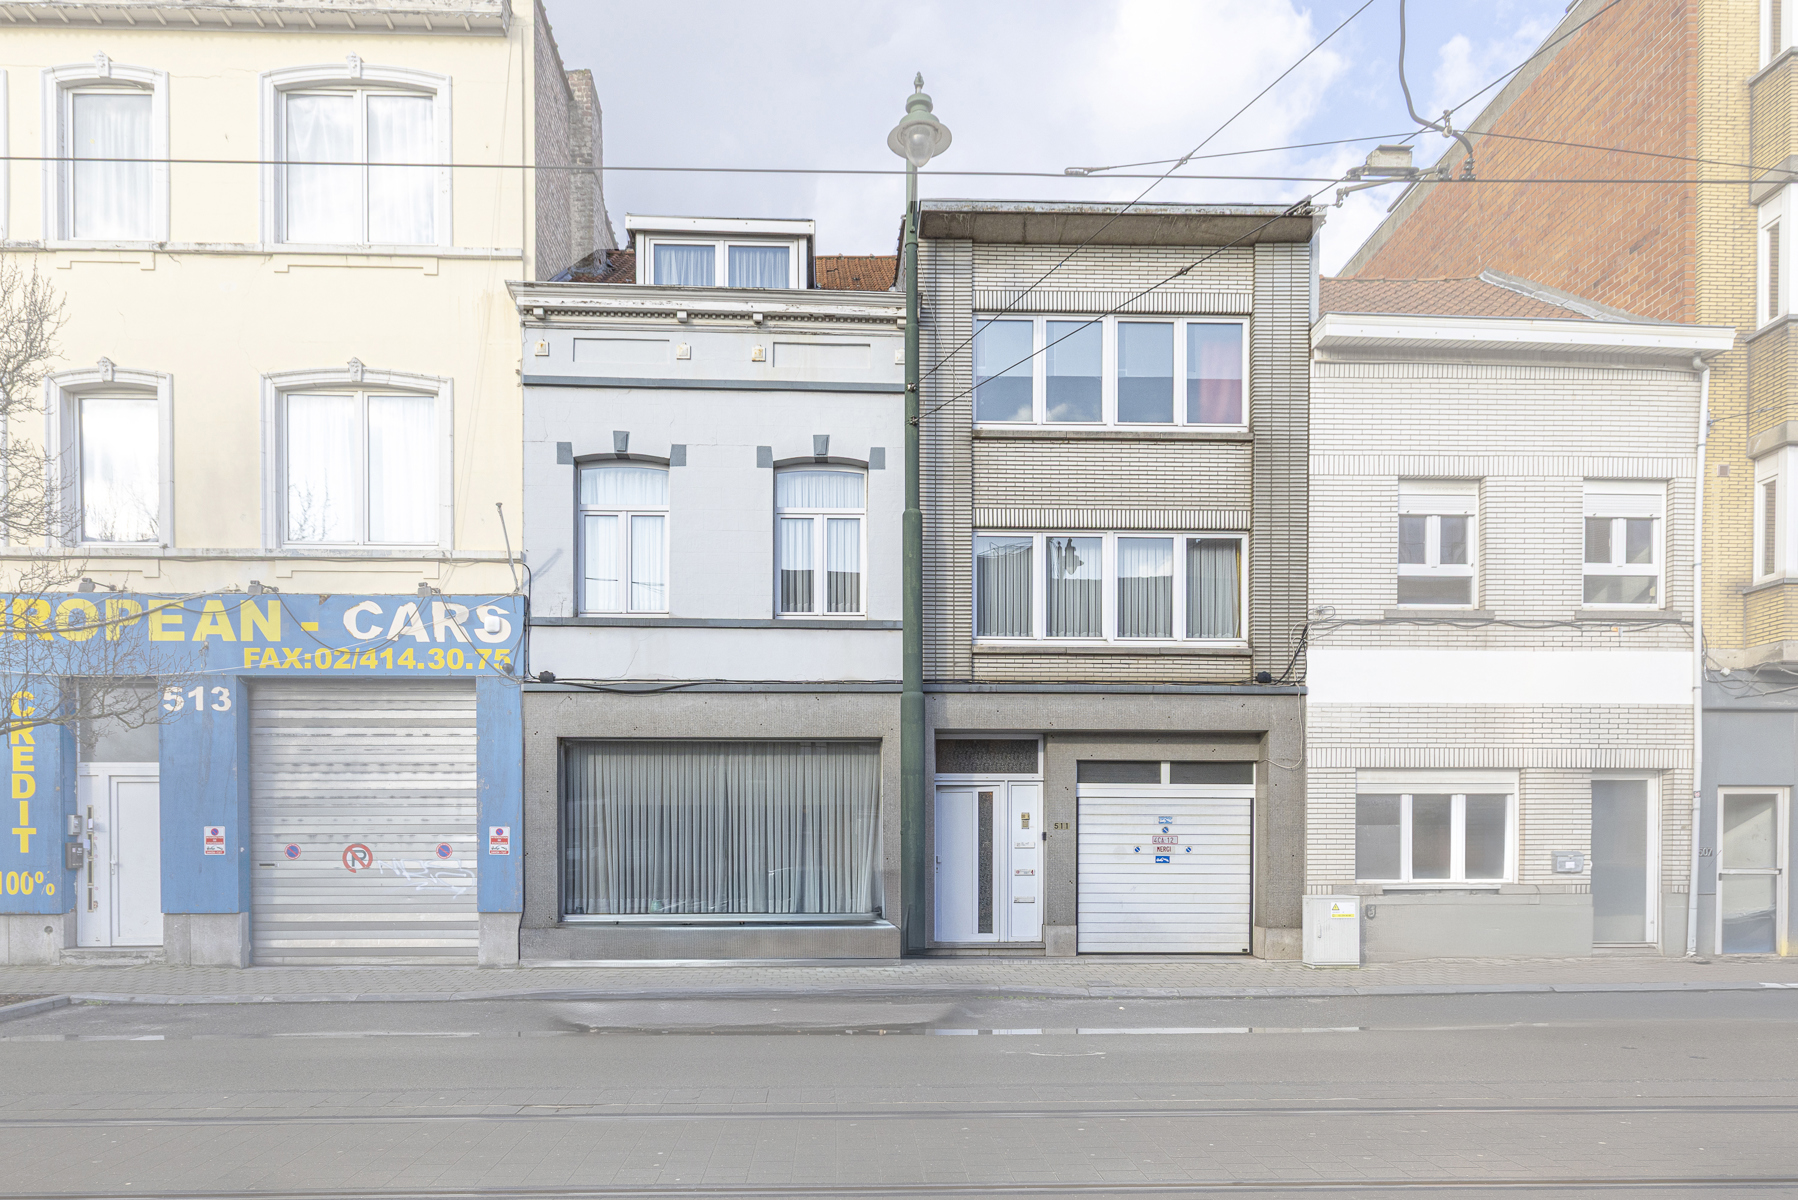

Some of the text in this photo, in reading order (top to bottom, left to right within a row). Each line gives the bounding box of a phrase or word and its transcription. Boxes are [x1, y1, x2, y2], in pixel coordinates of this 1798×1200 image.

[0, 598, 281, 642] ROPEAN
[343, 600, 512, 643] CARS
[244, 647, 511, 670] FAX:02/414.30.75
[163, 686, 232, 711] 513
[11, 690, 37, 853] CREDIT
[1054, 822, 1069, 830] 511
